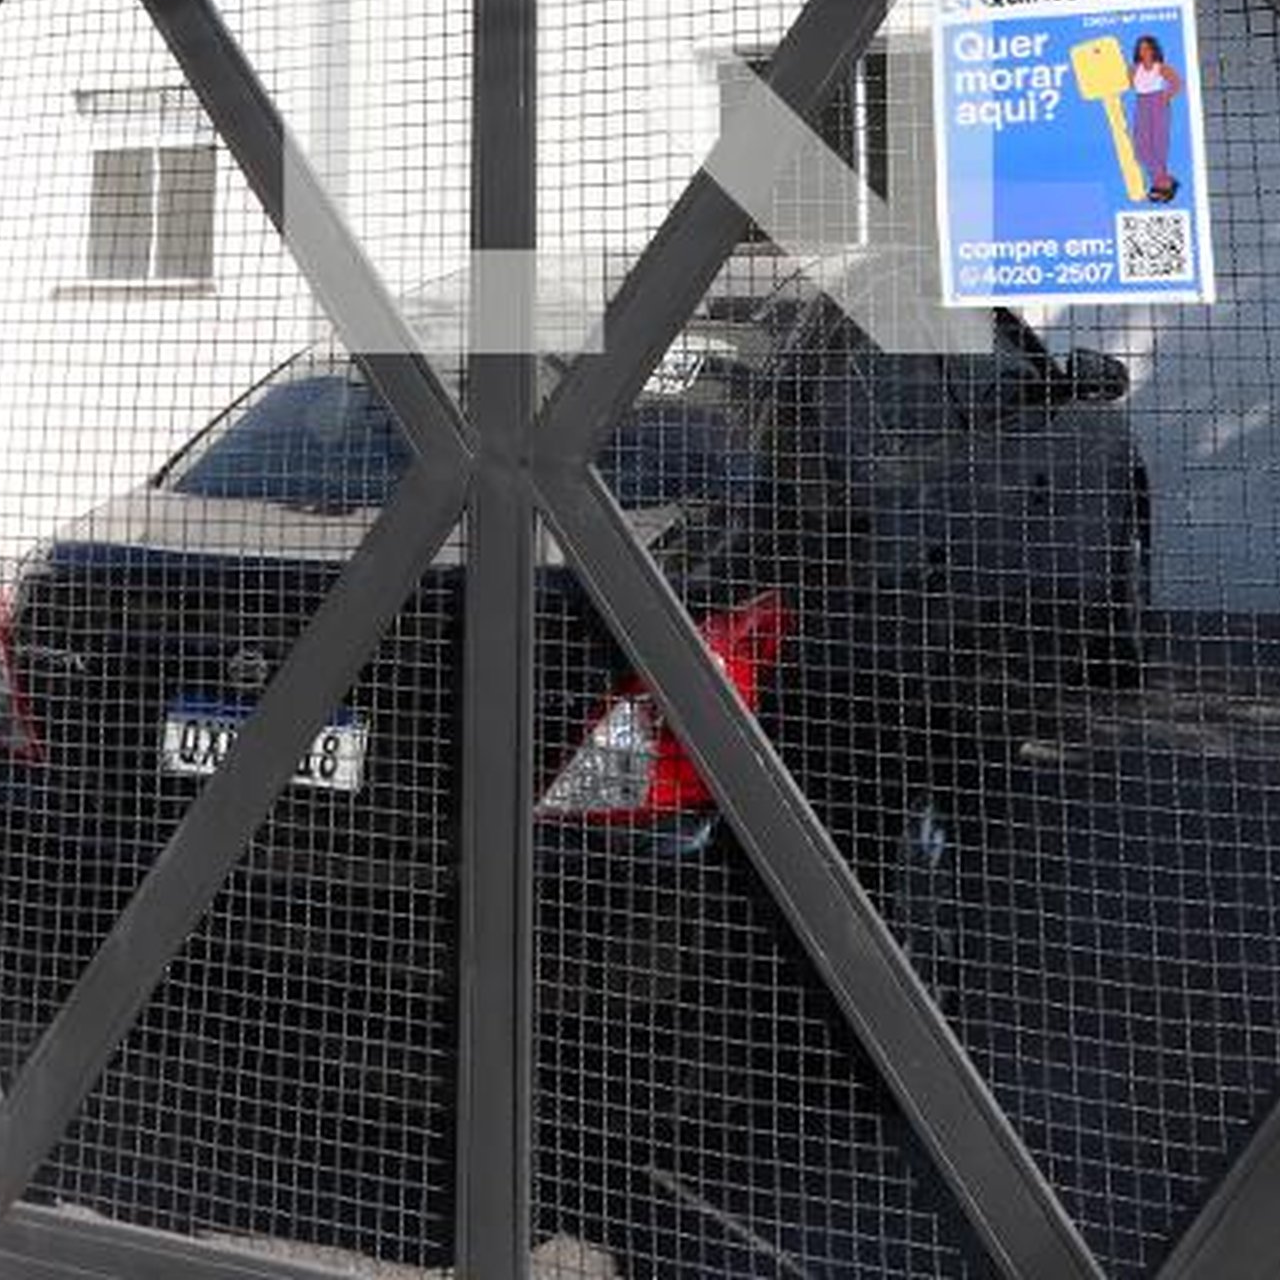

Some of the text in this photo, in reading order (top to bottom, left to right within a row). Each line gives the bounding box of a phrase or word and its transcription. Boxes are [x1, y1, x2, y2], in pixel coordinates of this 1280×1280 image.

[954, 31, 1049, 61] Quer
[956, 64, 1068, 93] morar
[957, 90, 1059, 131] aqui?
[959, 237, 1114, 262] compre em:
[981, 262, 1114, 285] 4020-2507
